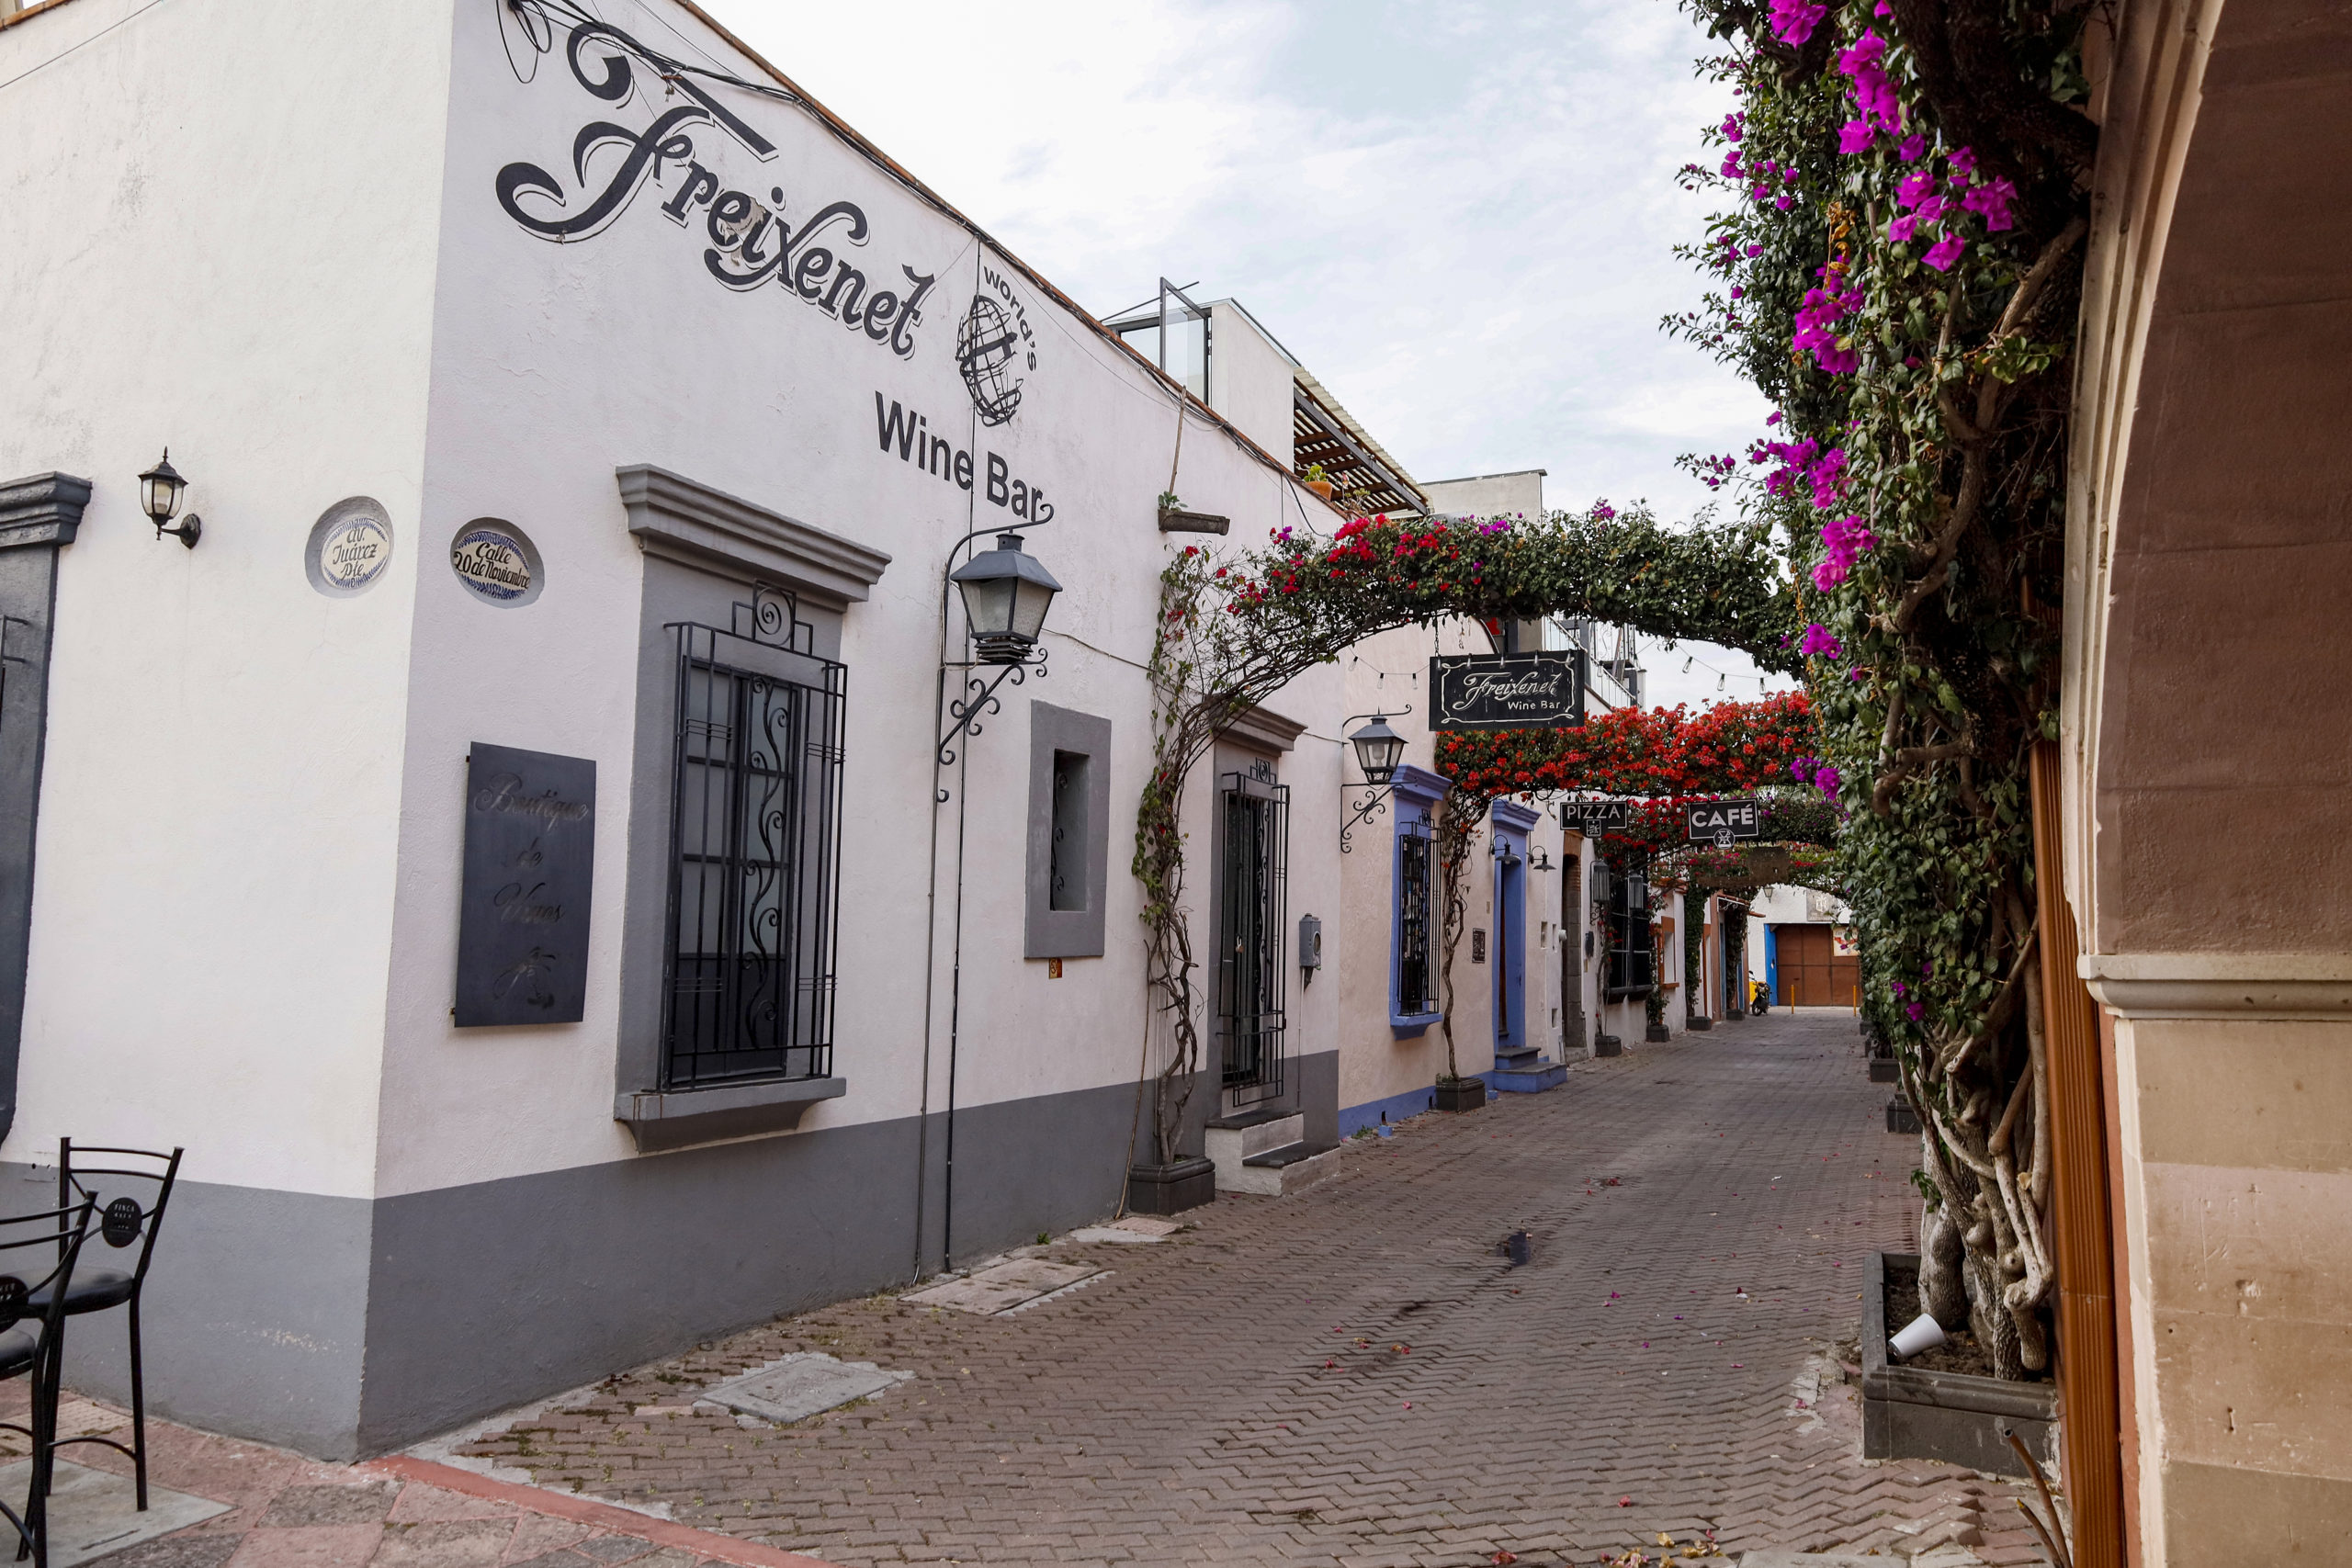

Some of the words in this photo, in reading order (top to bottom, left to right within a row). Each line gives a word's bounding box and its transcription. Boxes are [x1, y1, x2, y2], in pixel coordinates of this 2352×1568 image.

[495, 22, 935, 359] Freixenet
[983, 265, 1038, 373] world's
[875, 390, 974, 491] Wine
[987, 450, 1046, 524] Bar
[332, 543, 379, 565] Juárez
[453, 550, 472, 573] 20
[471, 558, 487, 577] de
[484, 559, 531, 590] Noviembre
[476, 542, 512, 565] Calle
[1452, 671, 1564, 711] Freixenet
[1508, 700, 1537, 711] Wine
[1541, 700, 1561, 710] Bar
[473, 772, 590, 831] Boutique
[1566, 805, 1621, 819] PIZZA
[1690, 804, 1755, 829] CAFÉ
[515, 836, 545, 870] de
